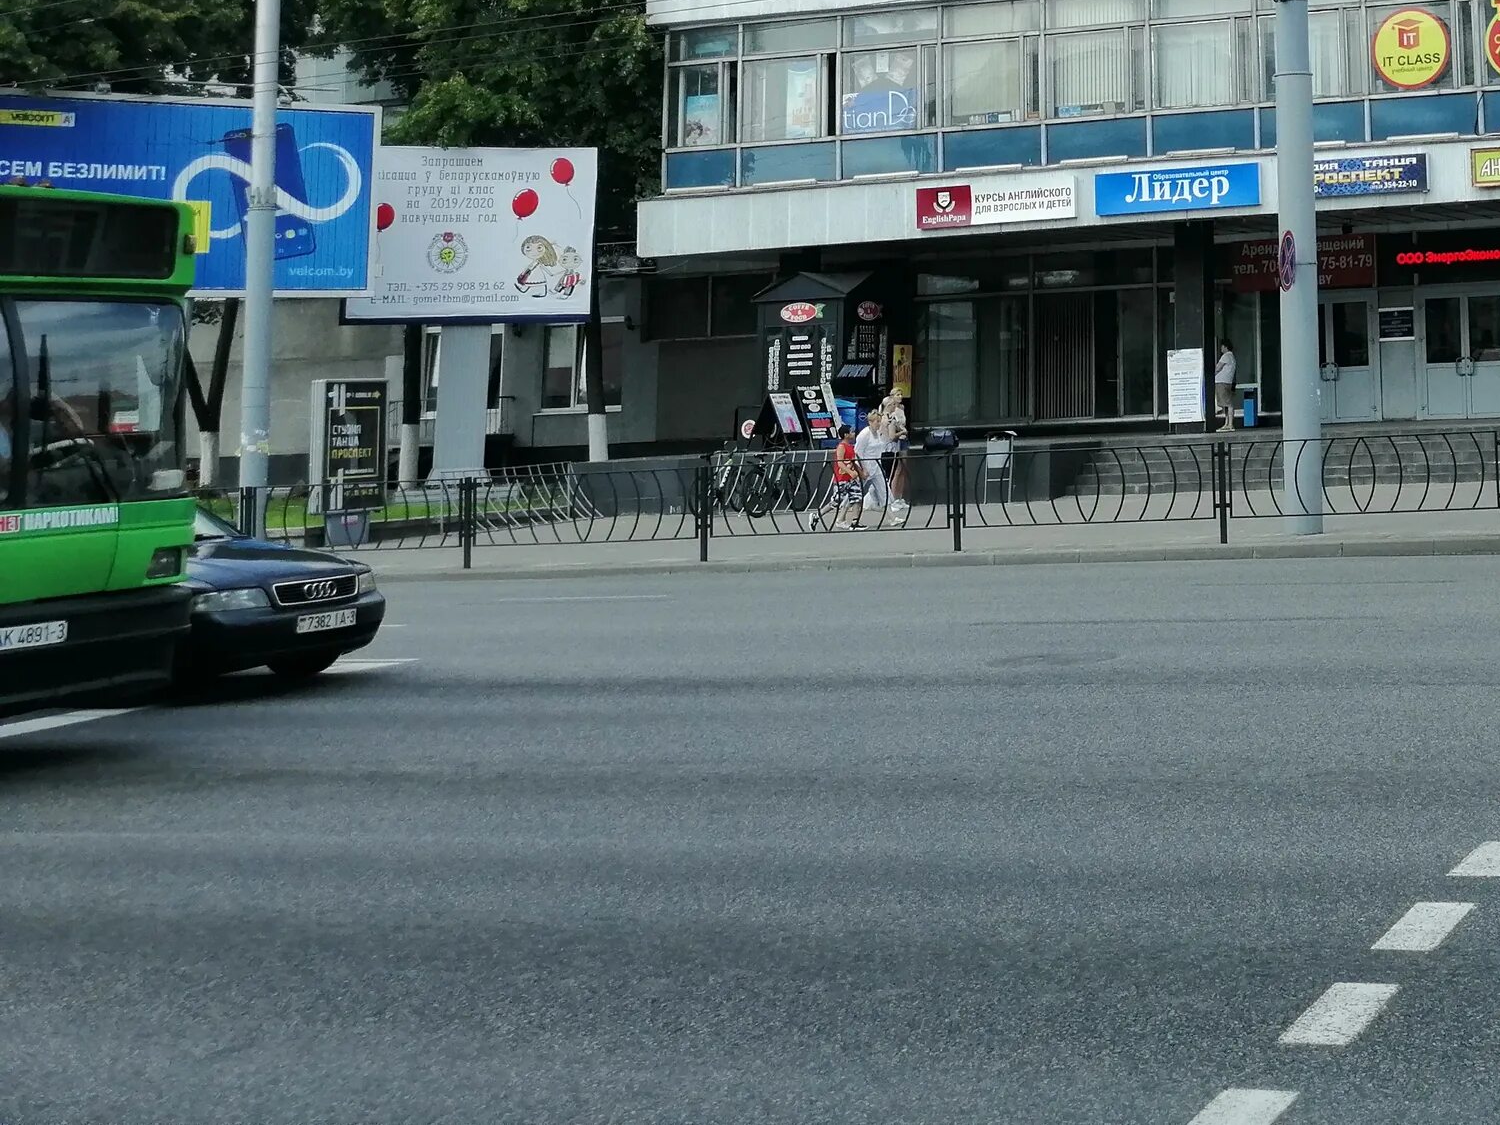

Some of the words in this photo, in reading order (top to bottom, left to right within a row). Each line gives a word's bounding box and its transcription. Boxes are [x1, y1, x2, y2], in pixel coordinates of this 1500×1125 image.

[1402, 32, 1417, 46] IT
[1383, 56, 1393, 67] IT
[1397, 53, 1441, 66] CLASS
[421, 156, 483, 167] Запрашаем
[1362, 157, 1417, 168] ТАНЦА
[0, 160, 42, 177] СЕМ
[48, 161, 166, 180] БЕЗЛИМИТ!
[439, 170, 540, 183] беларускамоўную
[1153, 170, 1209, 181] Образовательный
[1313, 168, 1403, 184] РОСПЕКТ
[407, 185, 443, 197] групу
[451, 185, 461, 196] ці
[468, 185, 495, 195] клас
[1125, 174, 1230, 205] Лидер
[1384, 179, 1417, 189] 354-22-10
[974, 192, 1005, 204] КУРСЫ
[1008, 187, 1072, 201] АНГЛИЙСКОГО
[406, 200, 420, 209] на
[430, 197, 495, 210] 2019/2020
[975, 204, 992, 215] ДЛЯ
[993, 201, 1037, 213] ВЗРОСЛЫХ
[1038, 200, 1045, 209] И
[1046, 198, 1072, 209] ДЕТЕЙ
[401, 213, 470, 225] навучальны
[477, 213, 498, 223] год
[922, 214, 966, 225] EnglishPapa
[1241, 241, 1279, 259] Аренд
[1317, 236, 1365, 253] ещений
[1232, 261, 1258, 275] тел.
[1321, 253, 1373, 271] 75-81-79
[1396, 251, 1424, 265] ООО
[288, 264, 354, 279] velcom.by
[416, 282, 439, 292] +375
[441, 282, 454, 291] 29
[456, 282, 477, 291] 908
[479, 282, 491, 291] 91
[493, 281, 505, 290] 62
[412, 293, 520, 306] gomeltbm@gmail.com
[331, 447, 372, 460] ПРОСПЕКТ
[24, 506, 119, 531] НАРКОТИКАМ!
[308, 615, 331, 630] 7382
[18, 623, 65, 644] 4891-3
